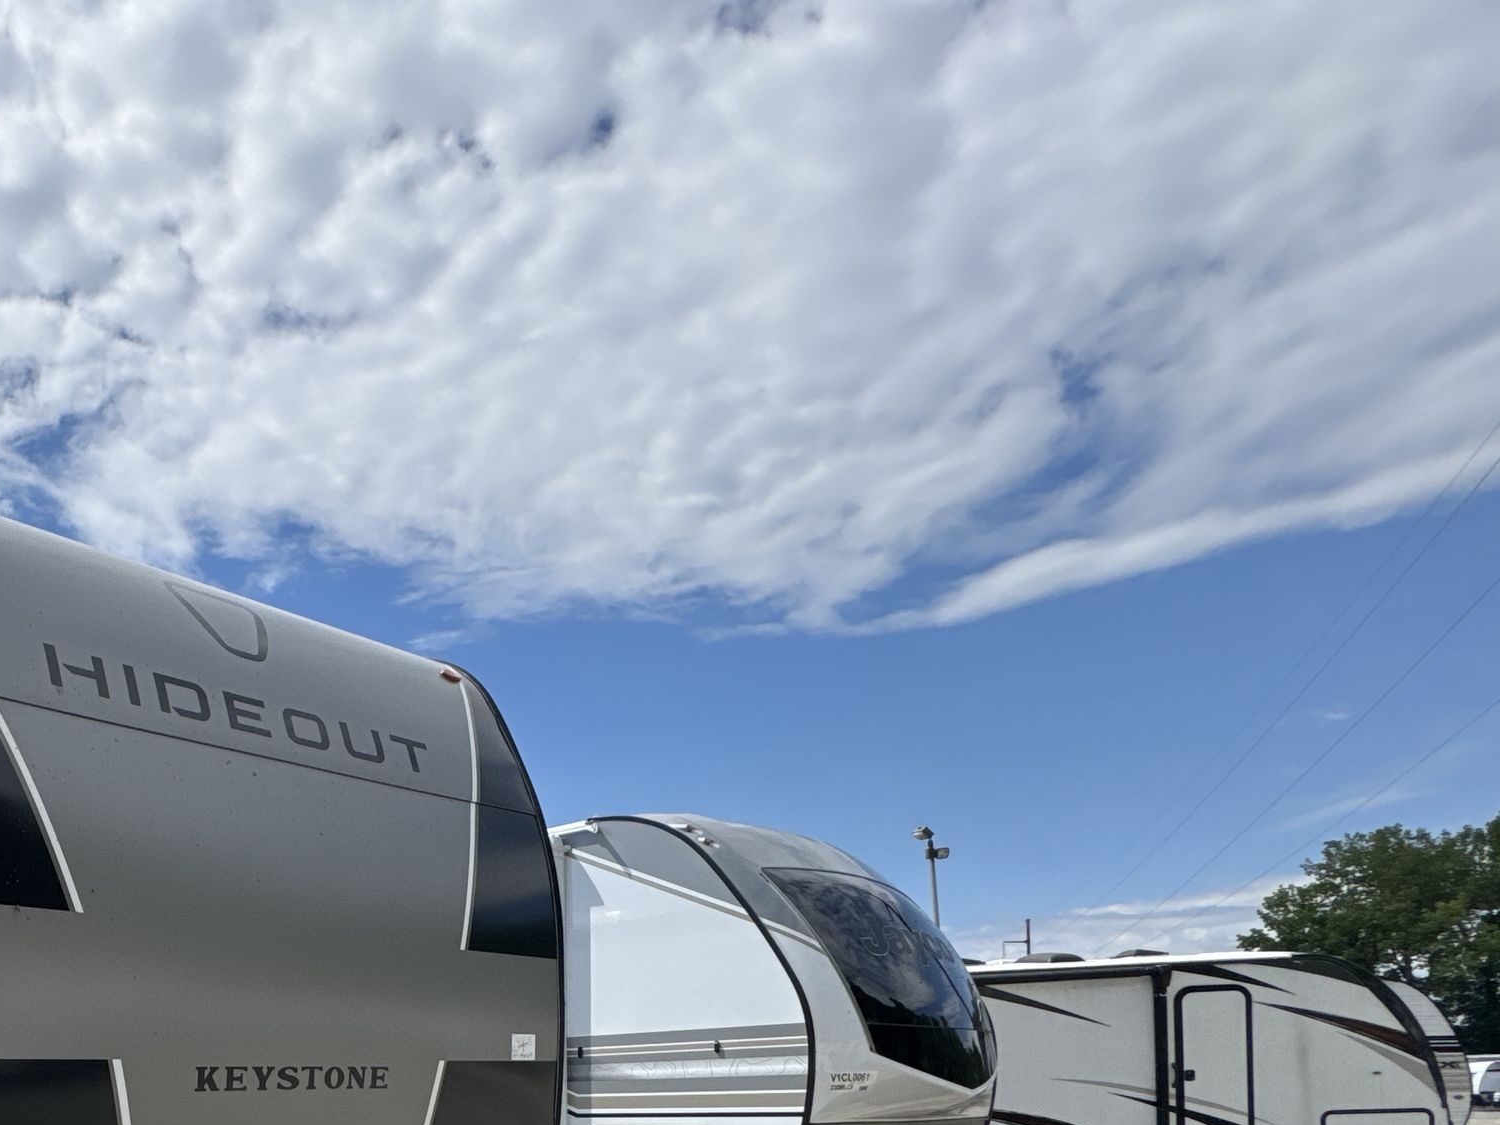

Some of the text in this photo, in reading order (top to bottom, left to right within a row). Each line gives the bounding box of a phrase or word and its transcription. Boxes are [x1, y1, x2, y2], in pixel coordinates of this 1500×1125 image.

[43, 642, 427, 773] HIDEOUT
[860, 925, 955, 965] Jayco
[194, 1066, 389, 1092] KEYSTONE
